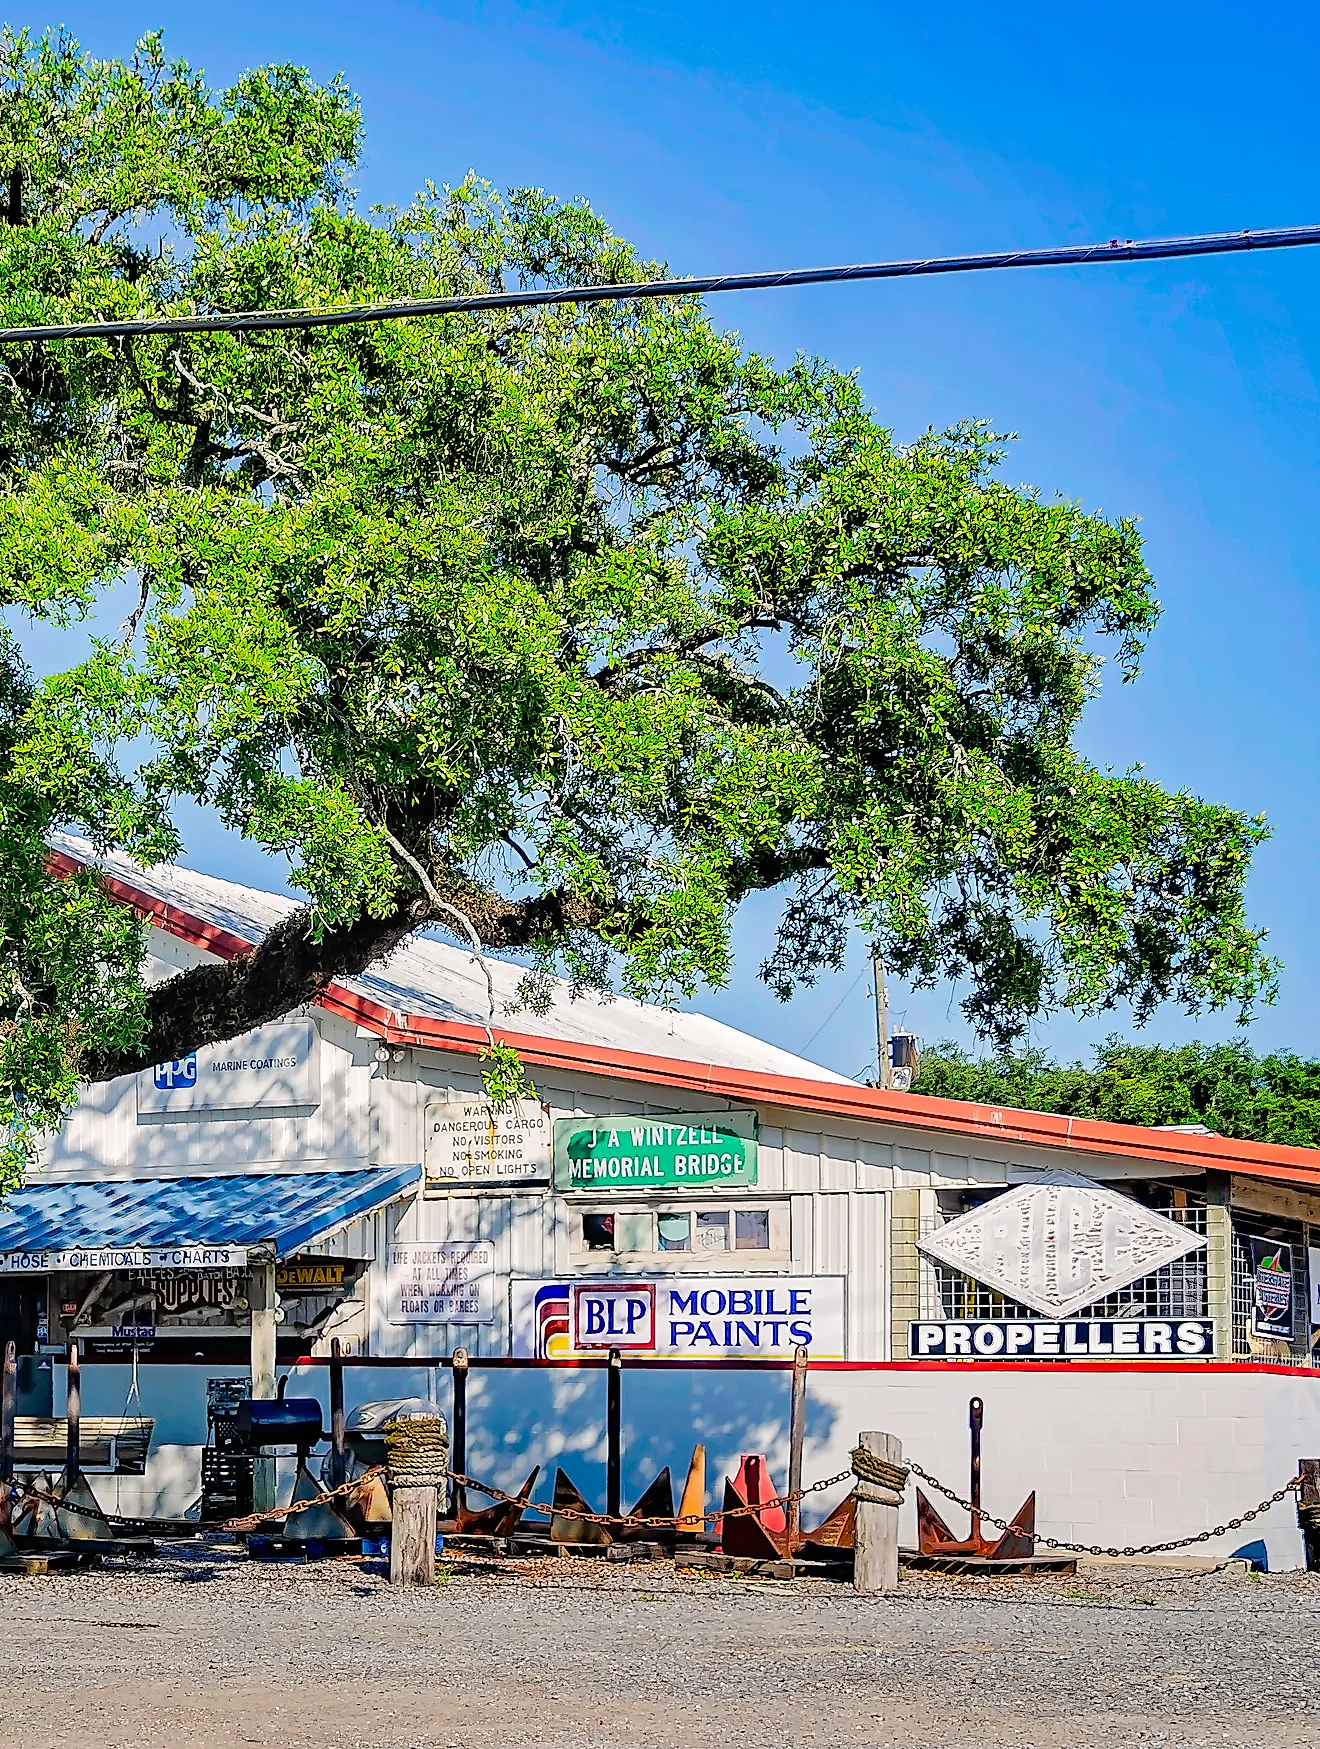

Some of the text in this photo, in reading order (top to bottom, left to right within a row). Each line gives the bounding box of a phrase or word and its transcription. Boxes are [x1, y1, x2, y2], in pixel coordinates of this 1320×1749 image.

[155, 1057, 196, 1087] PPG
[212, 1057, 296, 1072] MARINE COATINGS
[463, 1105, 513, 1116] WARNING
[433, 1118, 543, 1133] DANGEROUS CARGO
[452, 1134, 523, 1146] NO VISITORS
[587, 1124, 723, 1148] J A WINTZELL
[452, 1149, 523, 1161] NO SMOKING
[440, 1163, 537, 1176] NO OPEN LIGHTS
[569, 1153, 744, 1179] MEMORIAL BRIDGE
[11, 1254, 49, 1268] HOSE
[69, 1252, 151, 1267] CHEMICALS
[171, 1250, 230, 1264] CHARTS
[392, 1251, 489, 1264] LIFE JACKETS REQUIRED
[412, 1267, 468, 1280] AT ALL TIMES
[400, 1284, 480, 1297] WHEN WORKING ON
[401, 1300, 479, 1313] FLOATS OR BARGES
[669, 1289, 812, 1316] MOBILE
[584, 1298, 647, 1335] BLP
[111, 1324, 157, 1337] Mustad
[669, 1320, 813, 1348] PAINTS
[918, 1321, 1206, 1355] PROPELLERS
